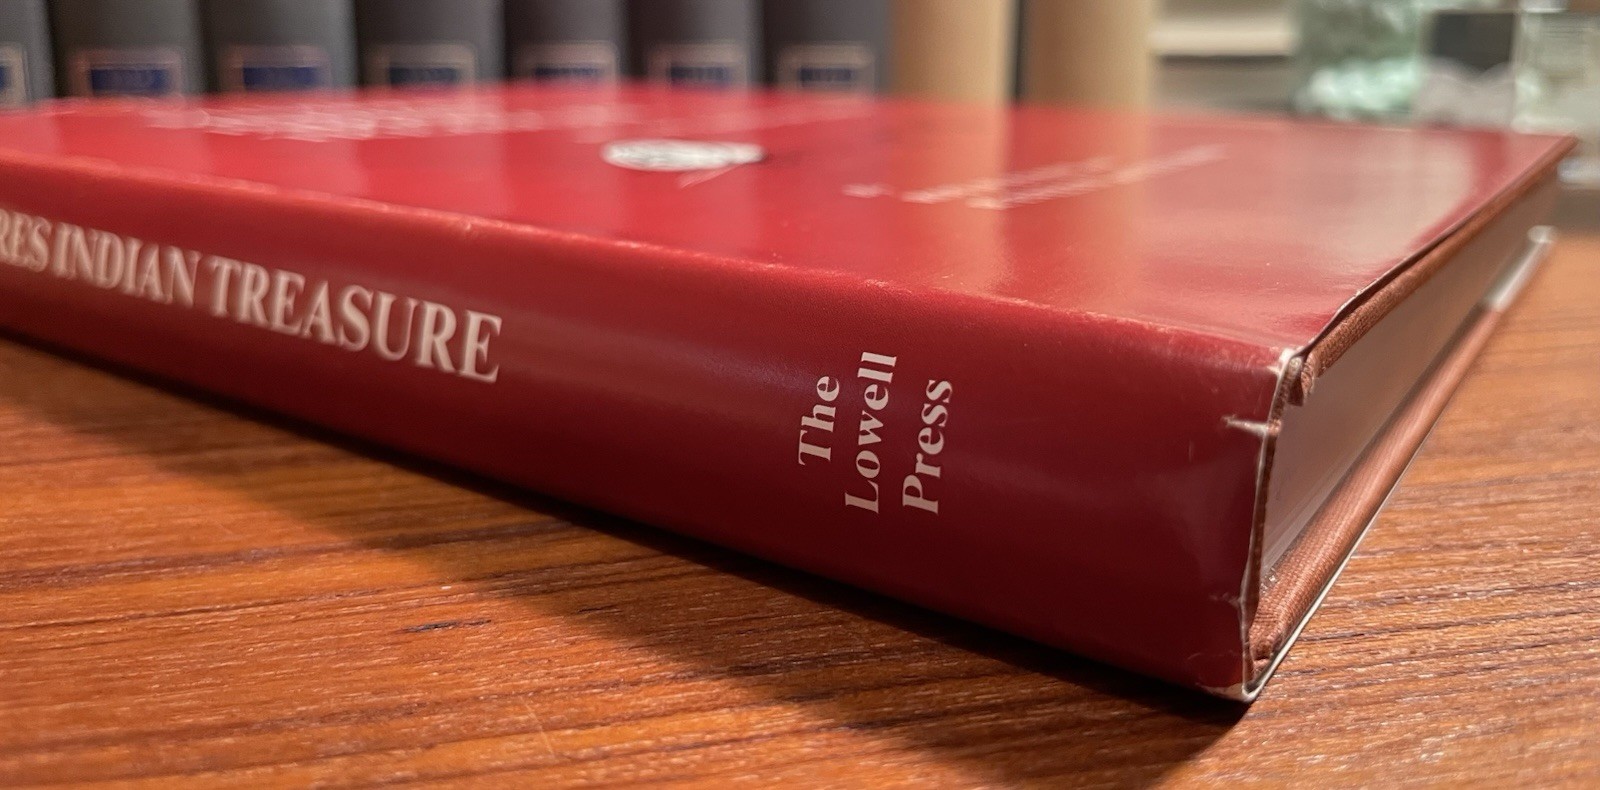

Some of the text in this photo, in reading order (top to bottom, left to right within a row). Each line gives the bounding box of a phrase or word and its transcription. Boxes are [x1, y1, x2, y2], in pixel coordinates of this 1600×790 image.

[52, 221, 201, 308] INDIAN
[206, 255, 502, 384] TREASURE
[798, 376, 840, 466] The
[844, 351, 897, 514] Lowell
[902, 379, 953, 515] Press
